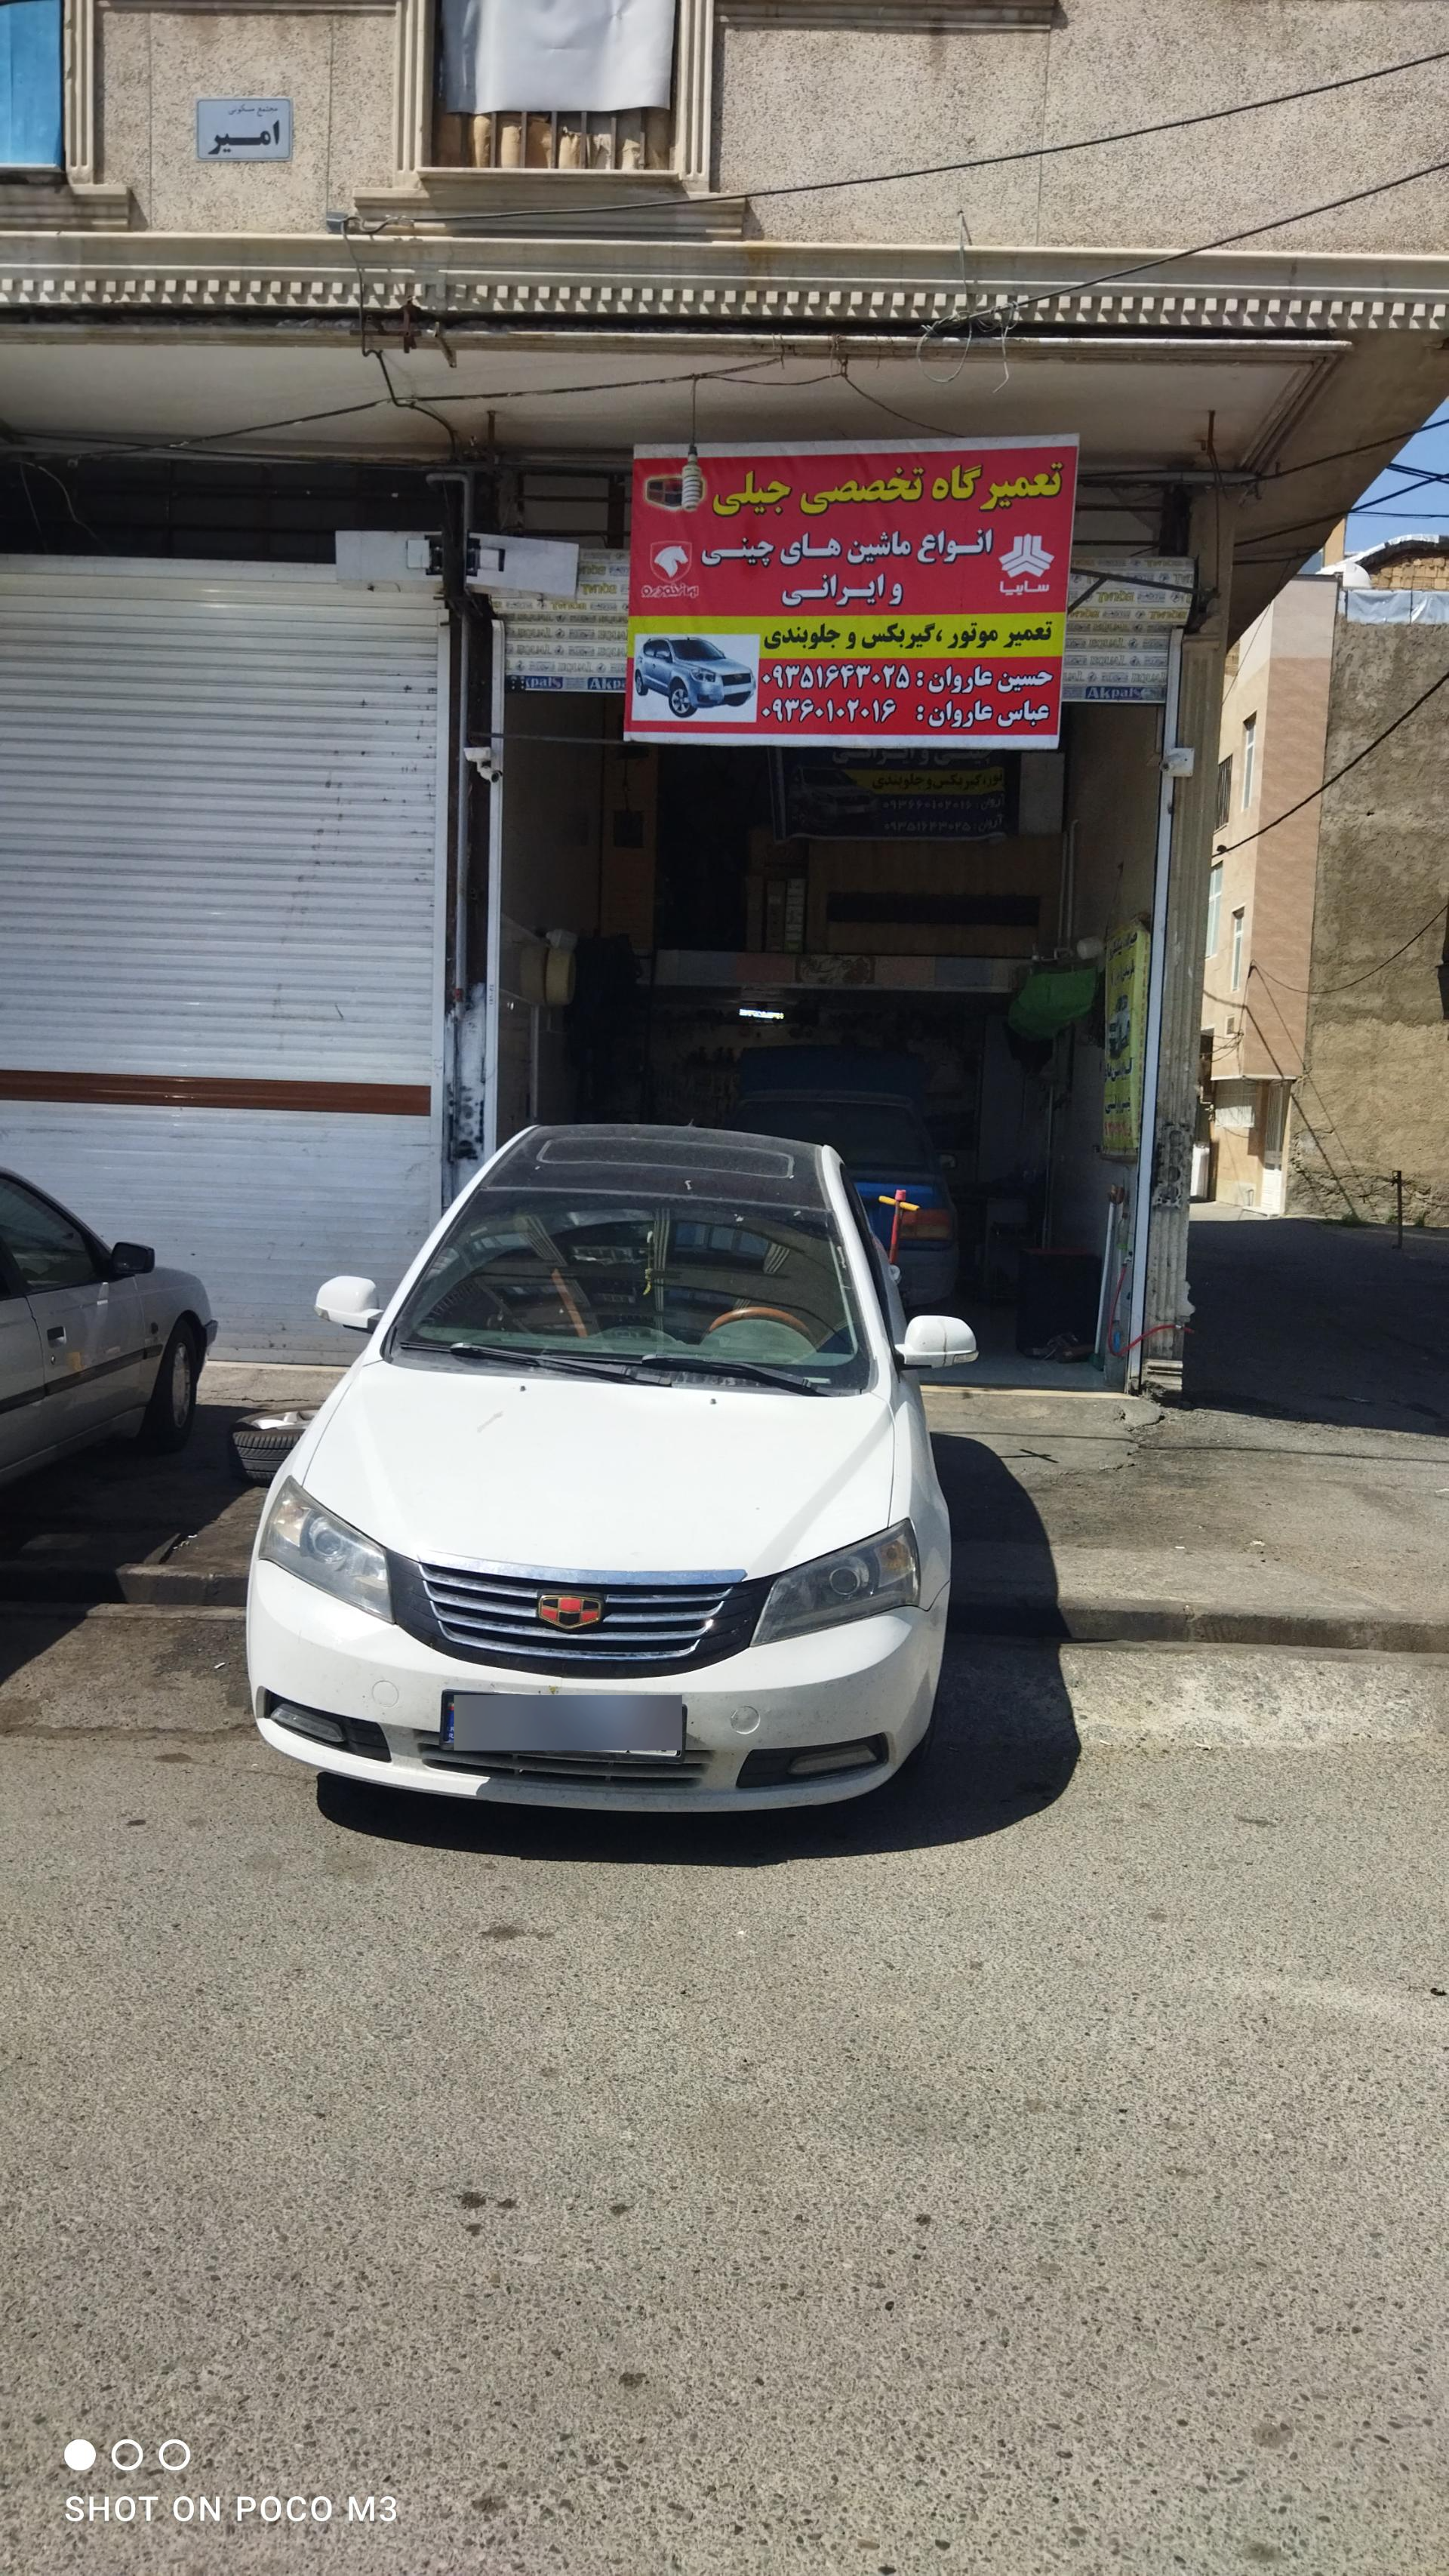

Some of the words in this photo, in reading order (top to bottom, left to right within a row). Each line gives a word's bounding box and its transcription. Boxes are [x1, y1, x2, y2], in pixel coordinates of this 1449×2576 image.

[208, 118, 279, 155] امیر
[712, 470, 792, 516] جیلی
[800, 466, 924, 515] تخصصی
[701, 537, 775, 566] چینی
[779, 532, 841, 565] های
[847, 531, 911, 564] ماشین
[917, 528, 993, 564] انواع
[782, 572, 885, 606] ایرانی
[889, 582, 903, 605] و
[999, 580, 1050, 596] سایپا
[764, 623, 841, 650] جلوبندی
[845, 631, 857, 649] و
[1003, 621, 1052, 648] تعمیر
[761, 663, 910, 689] ۰۹۳۵۱۶۴۳۰۲۵
[997, 669, 1053, 693] حسین
[761, 697, 897, 722] ۰۹۳۶۰۱۰۲۰۱۶
[997, 700, 1051, 727] عباس
